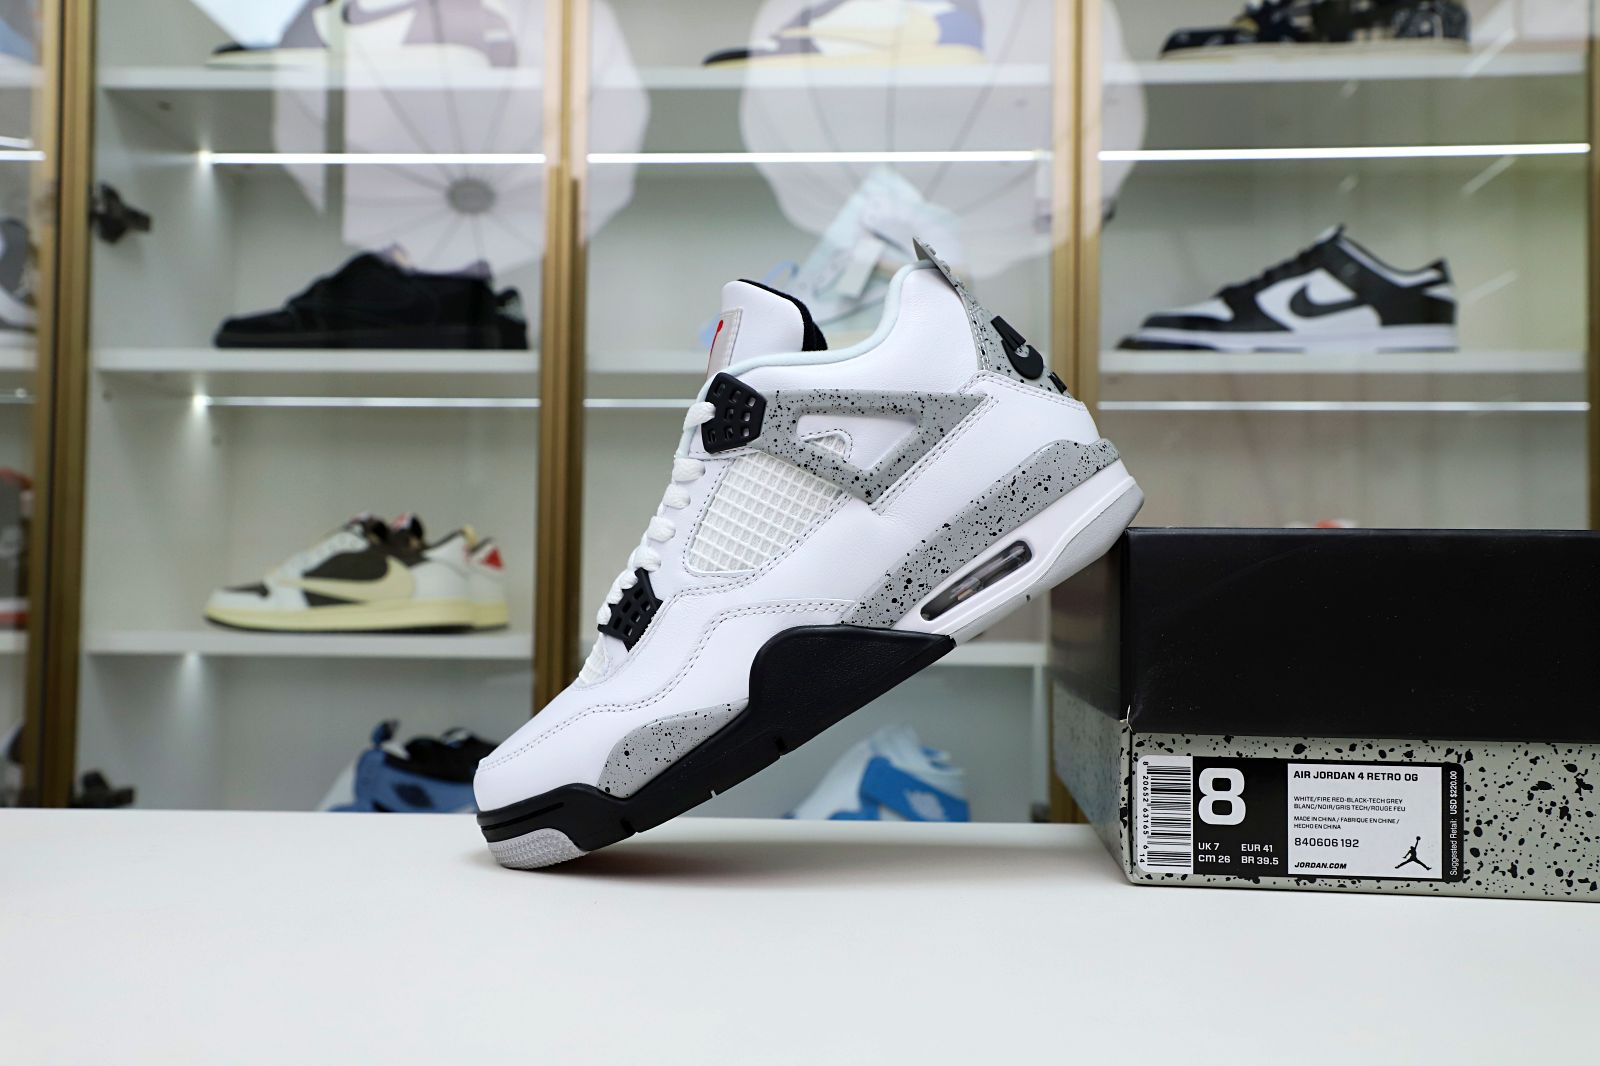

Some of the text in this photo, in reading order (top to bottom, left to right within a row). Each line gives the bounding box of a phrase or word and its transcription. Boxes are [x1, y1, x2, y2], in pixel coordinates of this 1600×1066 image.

[1294, 770, 1418, 782] AIR JORDAN 4 RETRO OG
[1198, 767, 1246, 826] 8
[1450, 770, 1460, 876] Suggested Retail: USD $220.00
[1198, 842, 1220, 850] UK 7
[1294, 838, 1360, 848] 840606 192
[1241, 844, 1273, 852] EUR 41
[1140, 854, 1145, 862] 14
[1218, 855, 1230, 864] 26
[1241, 856, 1279, 865] BR 39.5
[1294, 862, 1347, 870] JORDAN.COM
